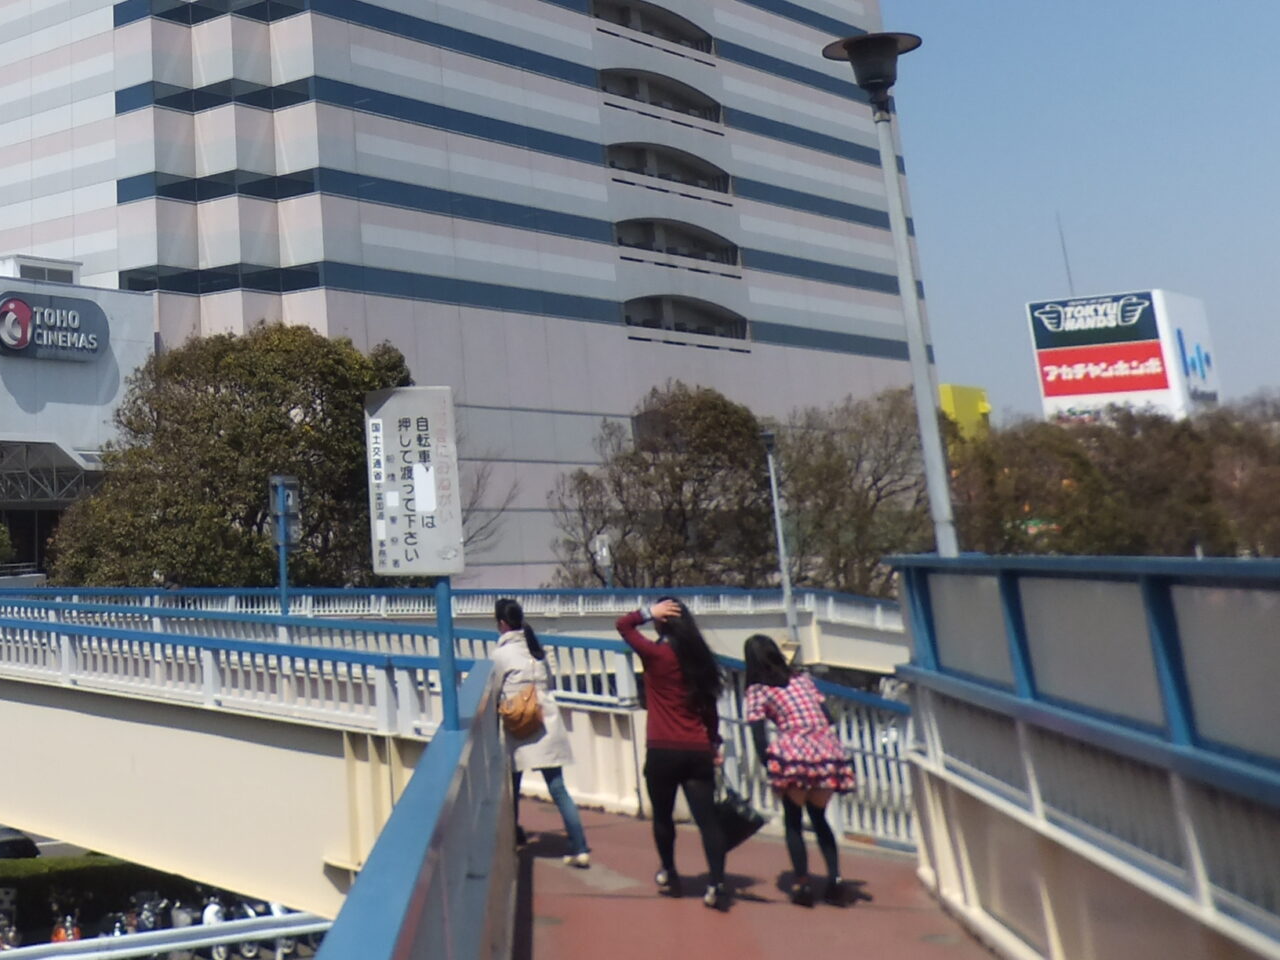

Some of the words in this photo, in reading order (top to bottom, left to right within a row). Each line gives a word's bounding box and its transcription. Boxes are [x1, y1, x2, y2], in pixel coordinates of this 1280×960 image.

[33, 306, 80, 329] TOHO
[1065, 302, 1117, 318] TOKYU
[1065, 315, 1117, 332] HANDS
[35, 329, 98, 350] CINEMAS
[1043, 357, 1163, 382] アカチャンホンポ
[397, 417, 419, 562] 押して渡って下さい
